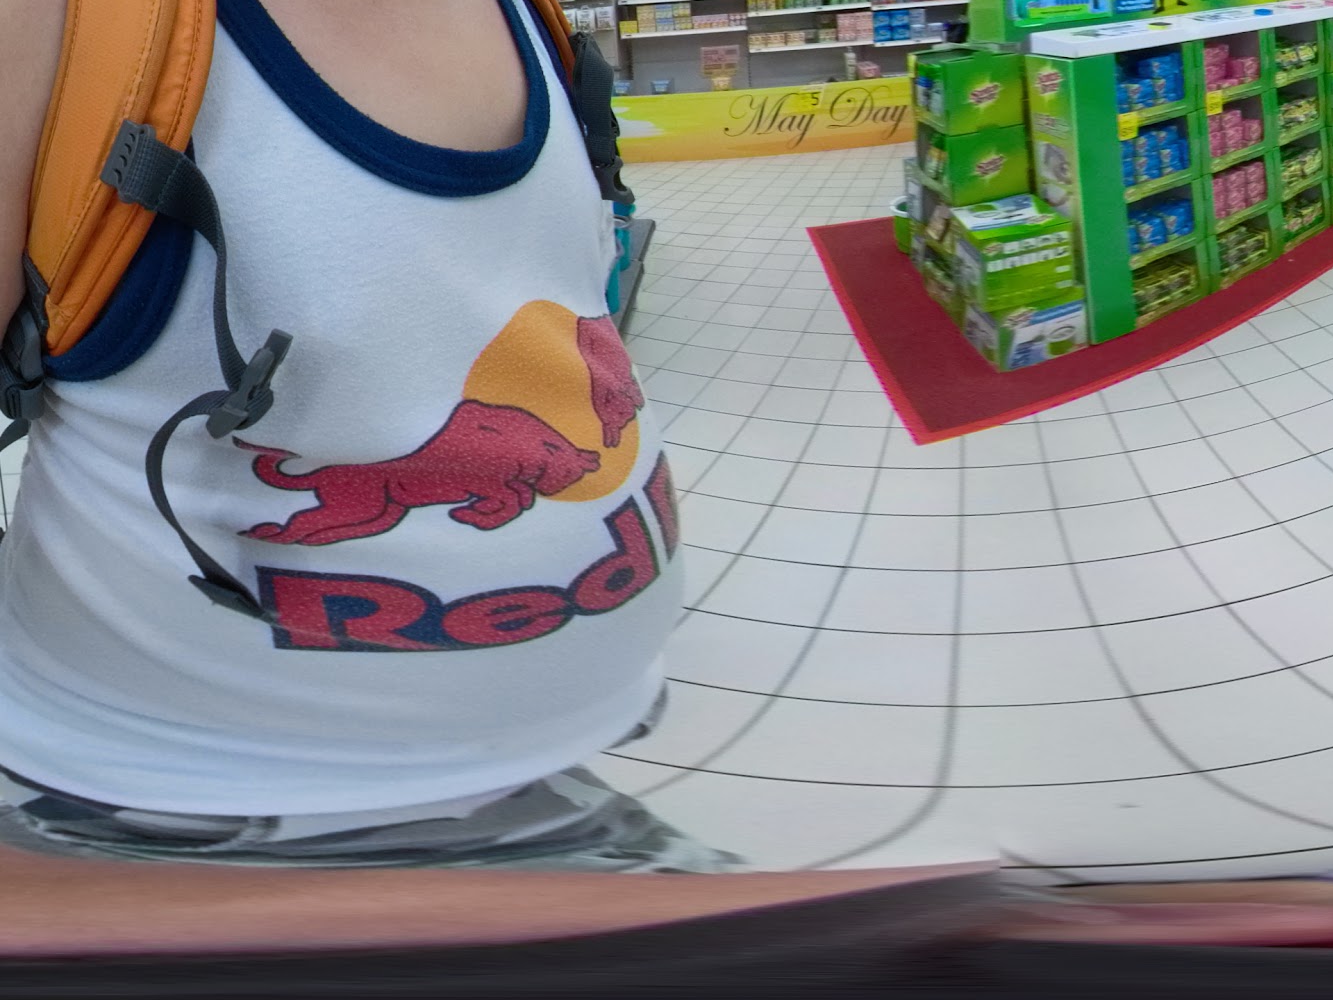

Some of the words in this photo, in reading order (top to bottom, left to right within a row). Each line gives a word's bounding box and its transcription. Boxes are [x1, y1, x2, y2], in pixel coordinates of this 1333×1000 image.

[724, 92, 815, 150] May
[826, 85, 908, 141] Day
[254, 494, 662, 653] Red
